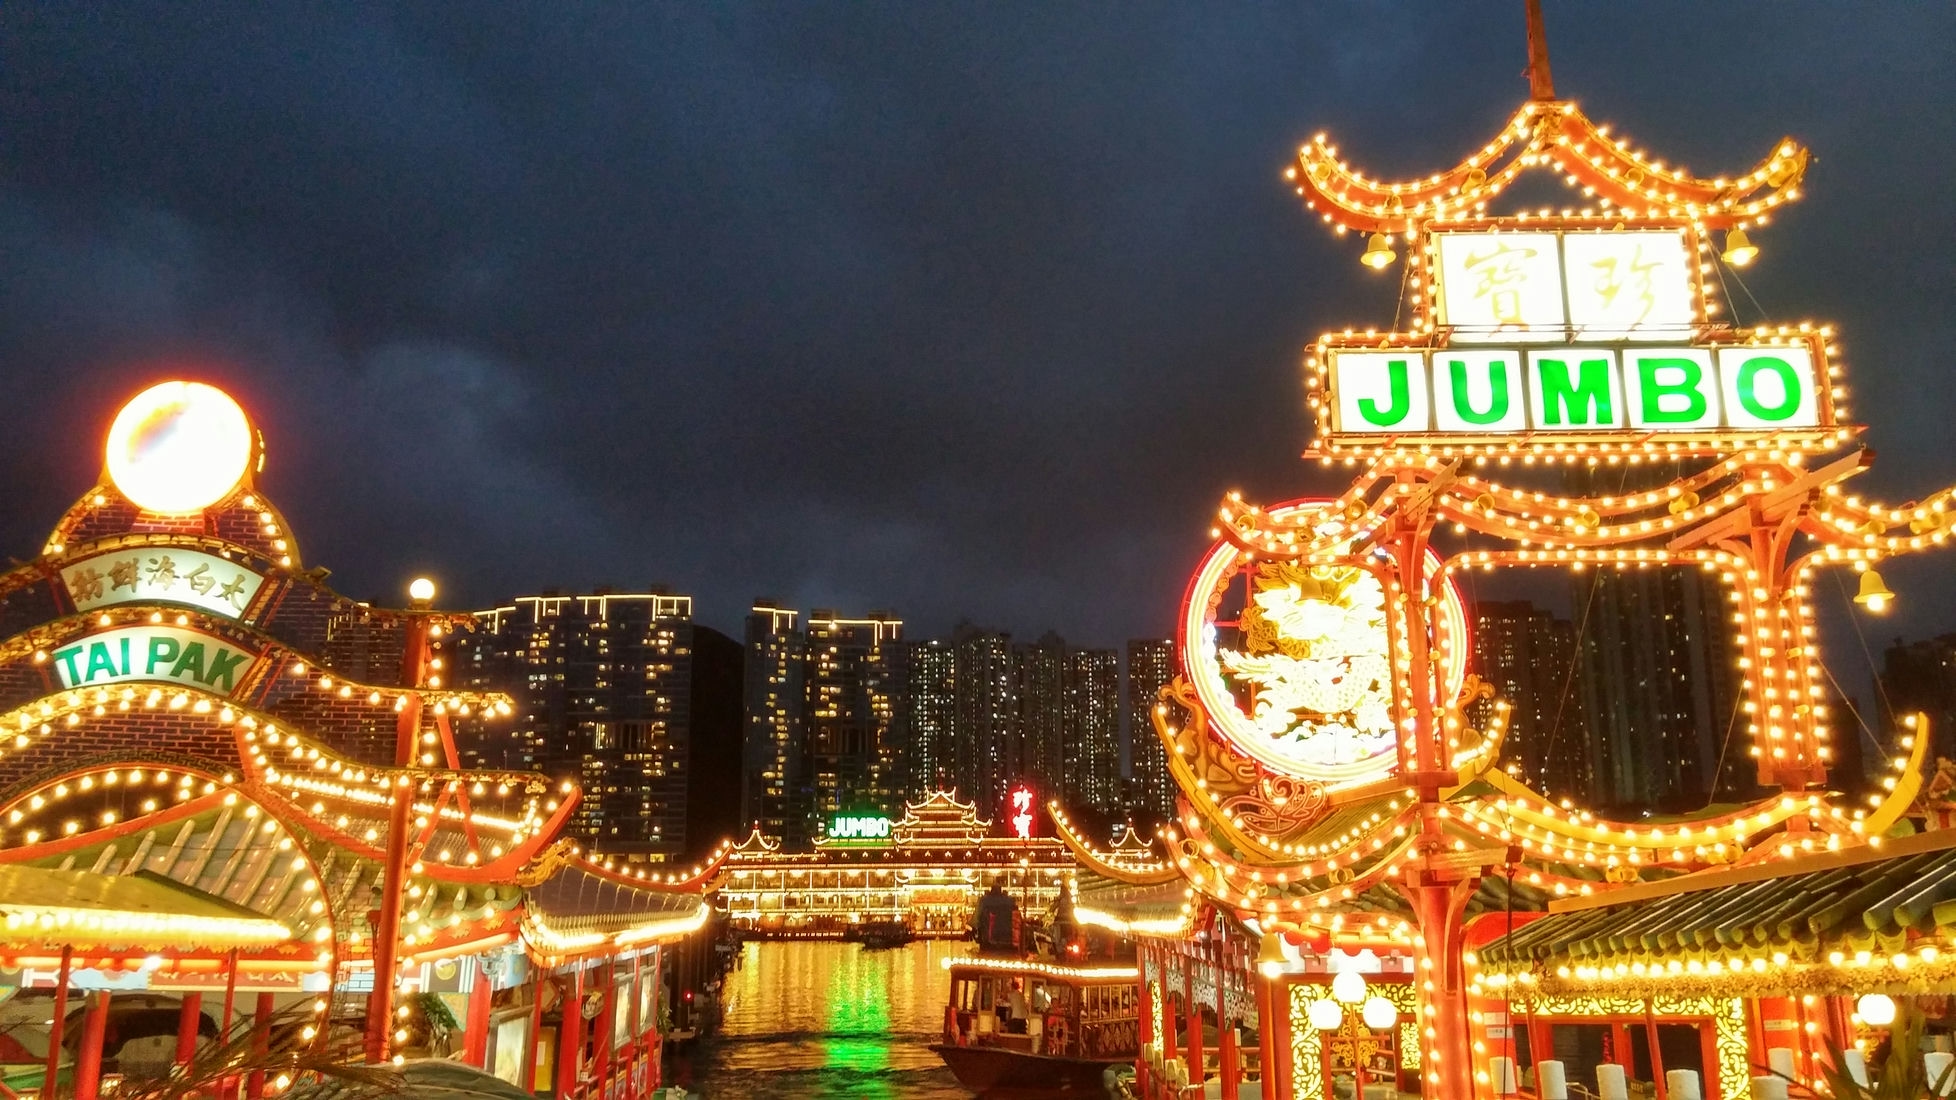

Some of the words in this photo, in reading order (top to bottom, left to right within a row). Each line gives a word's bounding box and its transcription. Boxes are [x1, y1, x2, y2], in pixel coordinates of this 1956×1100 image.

[1357, 356, 1802, 426] JUMBO
[53, 637, 131, 687] TAI
[145, 636, 249, 693] PAK
[829, 817, 889, 837] JUMBO
